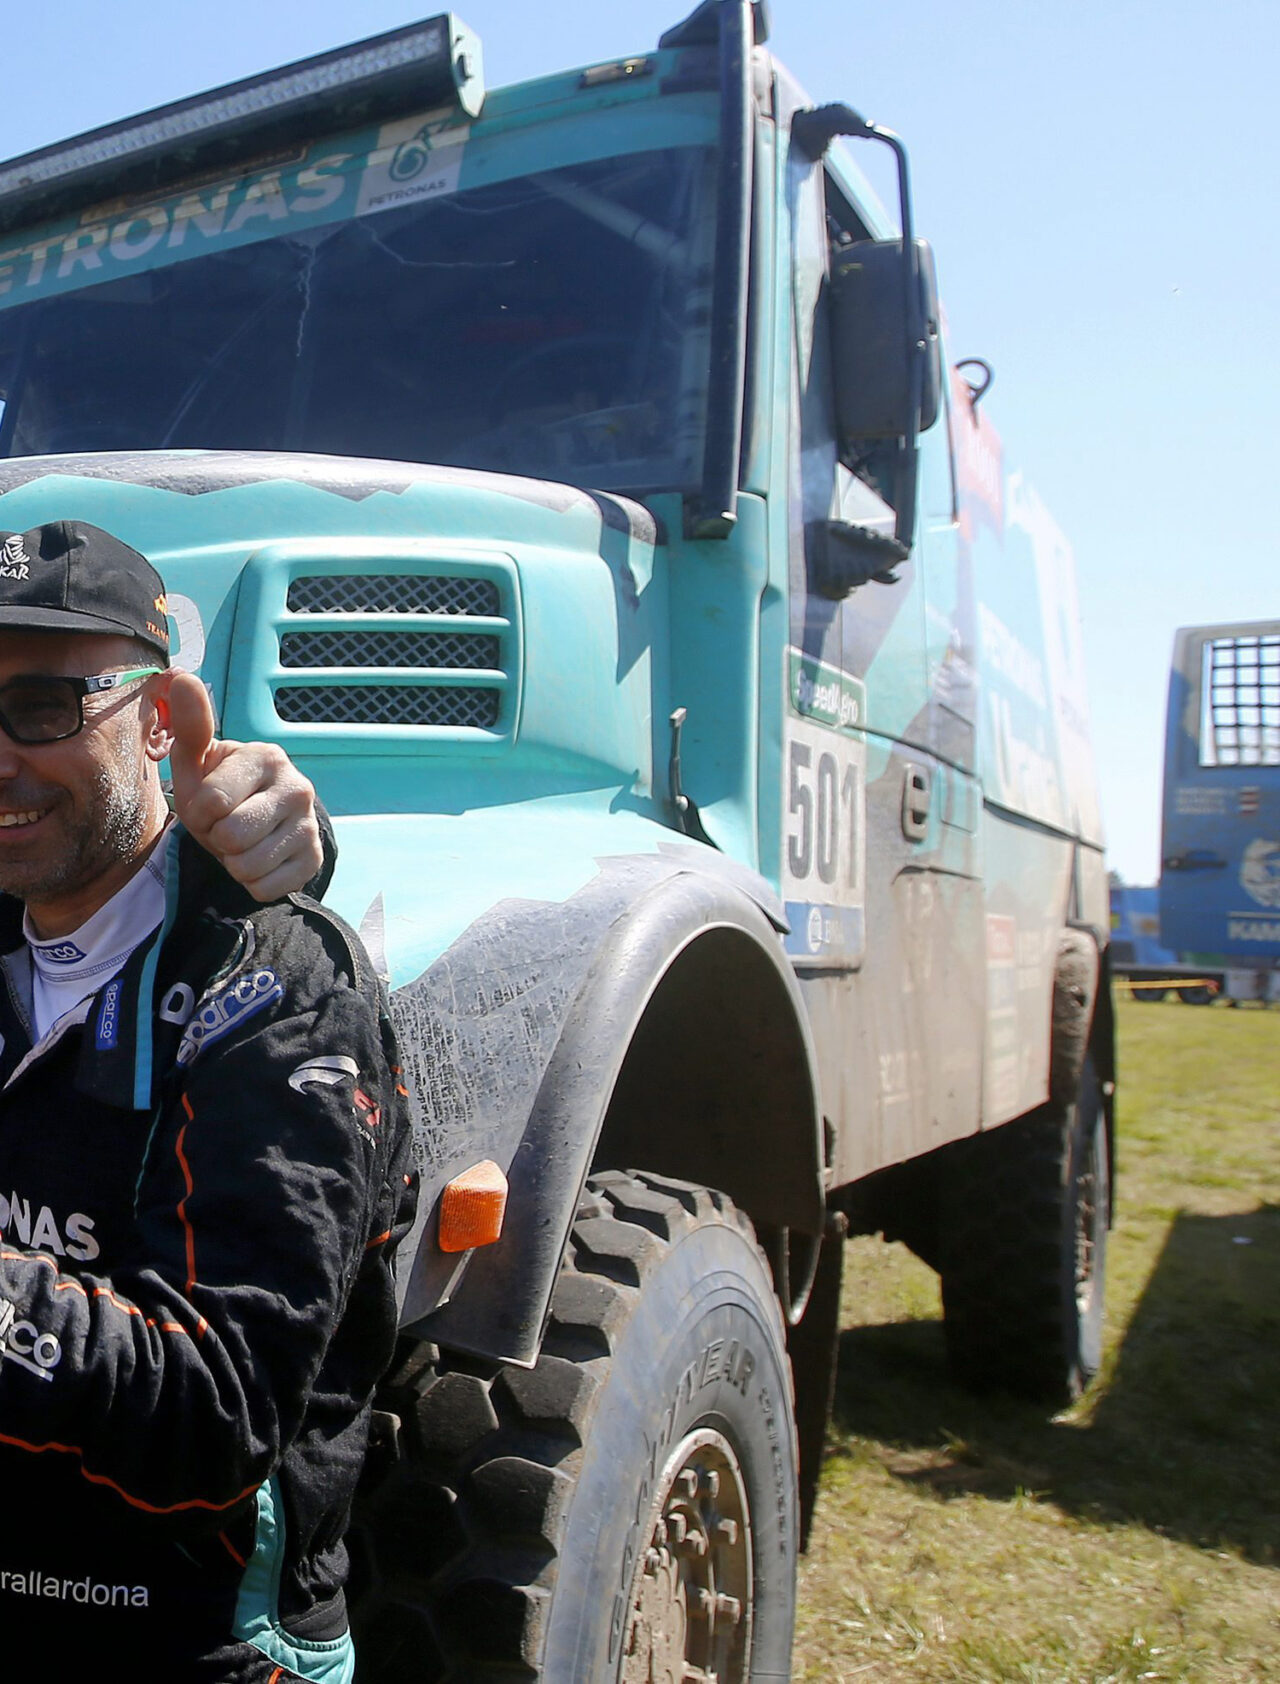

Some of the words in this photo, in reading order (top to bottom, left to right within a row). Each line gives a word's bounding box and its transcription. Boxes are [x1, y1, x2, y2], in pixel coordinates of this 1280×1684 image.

[368, 178, 447, 207] PETRONAS
[787, 740, 857, 890] 501
[100, 983, 119, 1040] sparco
[177, 969, 280, 1064] sparco
